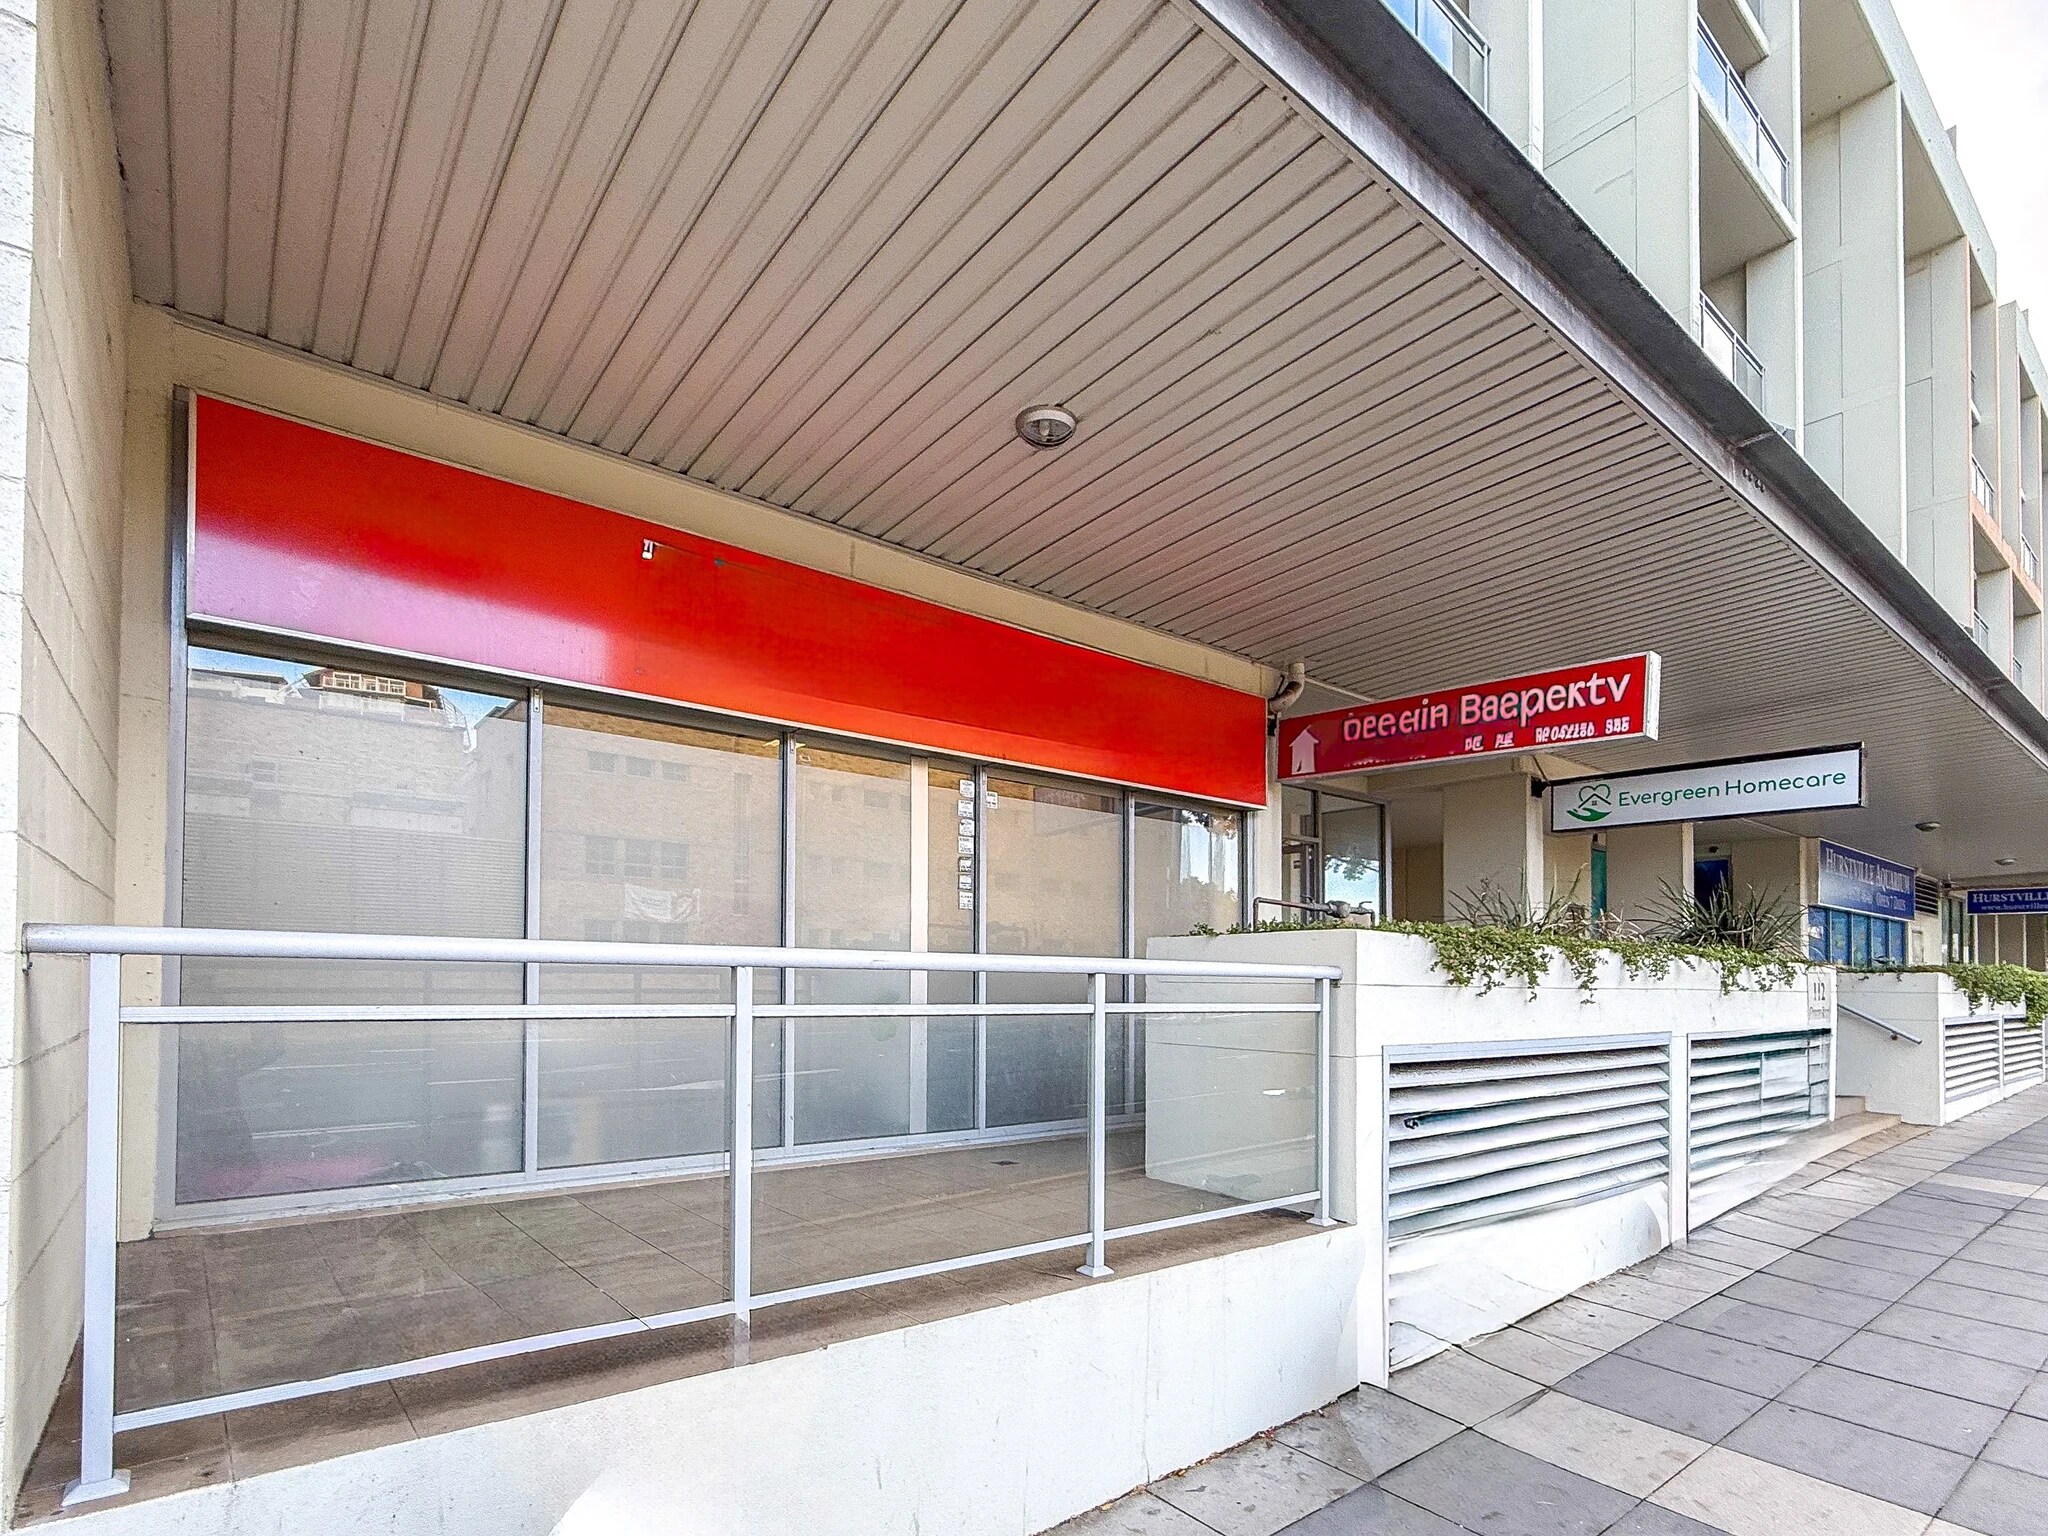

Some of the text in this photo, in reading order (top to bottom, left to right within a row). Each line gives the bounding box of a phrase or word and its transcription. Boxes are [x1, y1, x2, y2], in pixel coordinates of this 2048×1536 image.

[1618, 771, 1846, 807] Evergreen Homecare
[1813, 982, 1826, 1001] 112
